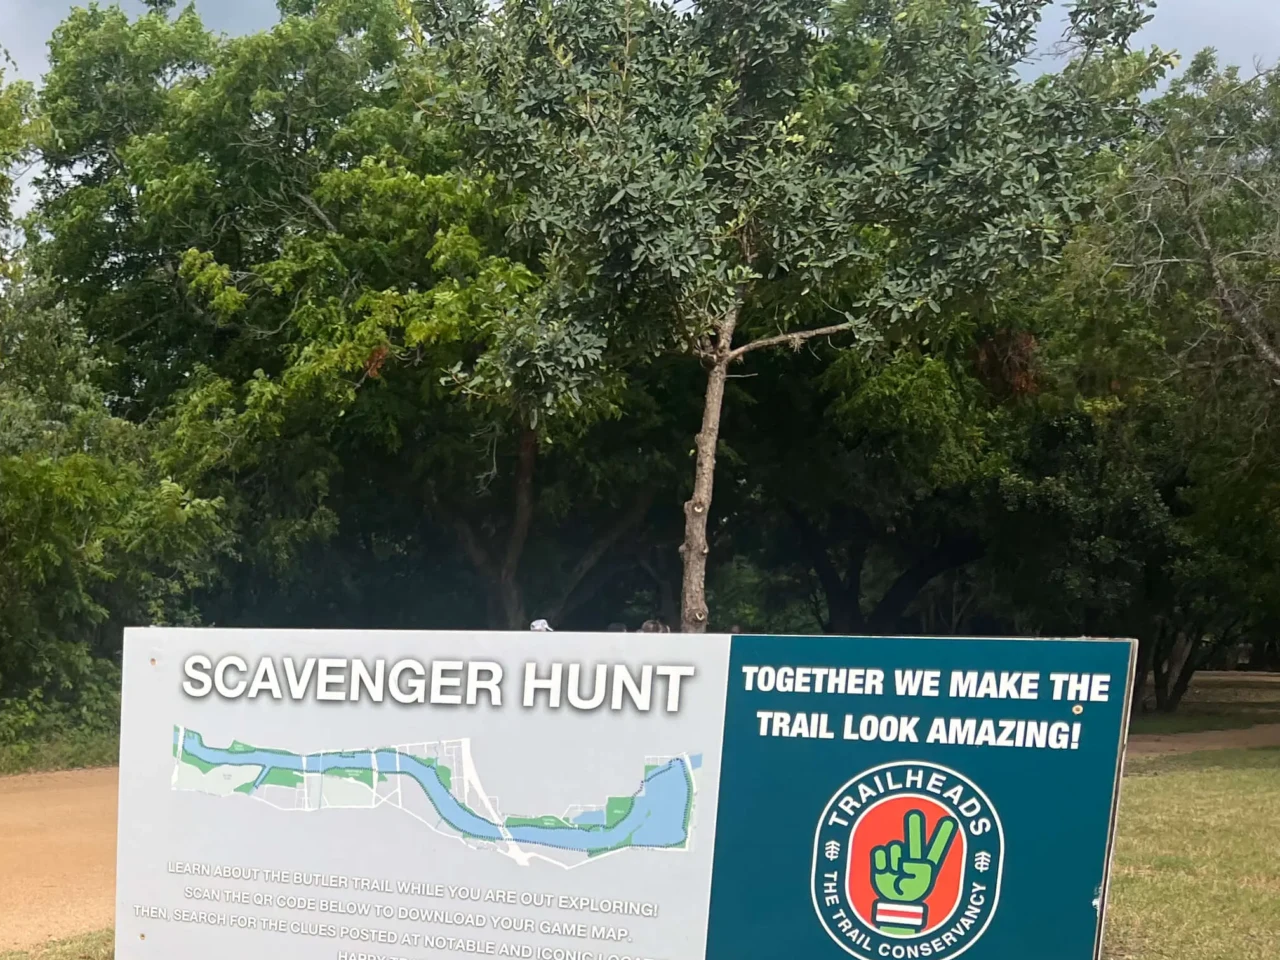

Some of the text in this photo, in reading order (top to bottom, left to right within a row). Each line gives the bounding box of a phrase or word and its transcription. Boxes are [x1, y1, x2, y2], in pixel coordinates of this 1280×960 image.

[182, 654, 695, 712] SCAVENGER HUNT
[742, 666, 1111, 702] TOGETHER WE MAKE THE
[757, 712, 1082, 750] TRAIL LOOK AMAZING!
[828, 769, 992, 836] TRAILHEADS
[168, 861, 658, 917] LEARN ABOUT THE BUTLER TRAIL WHILE YOU ARE OUT EXPLORING!
[184, 887, 632, 942] SCAN THE QR CODE BELOW TO DOWNLOAD YOUR GAME MAP.
[823, 871, 986, 958] THE TRAIL CONSERVANCY
[133, 904, 171, 920] THEN,
[173, 909, 227, 925] SEARCH
[230, 915, 257, 929] FOR
[260, 919, 286, 932] THE
[290, 921, 336, 937] CLUES
[339, 926, 397, 944] POSTED
[401, 933, 420, 946] AT
[424, 936, 495, 954] NOTABLE
[499, 943, 533, 958] AND
